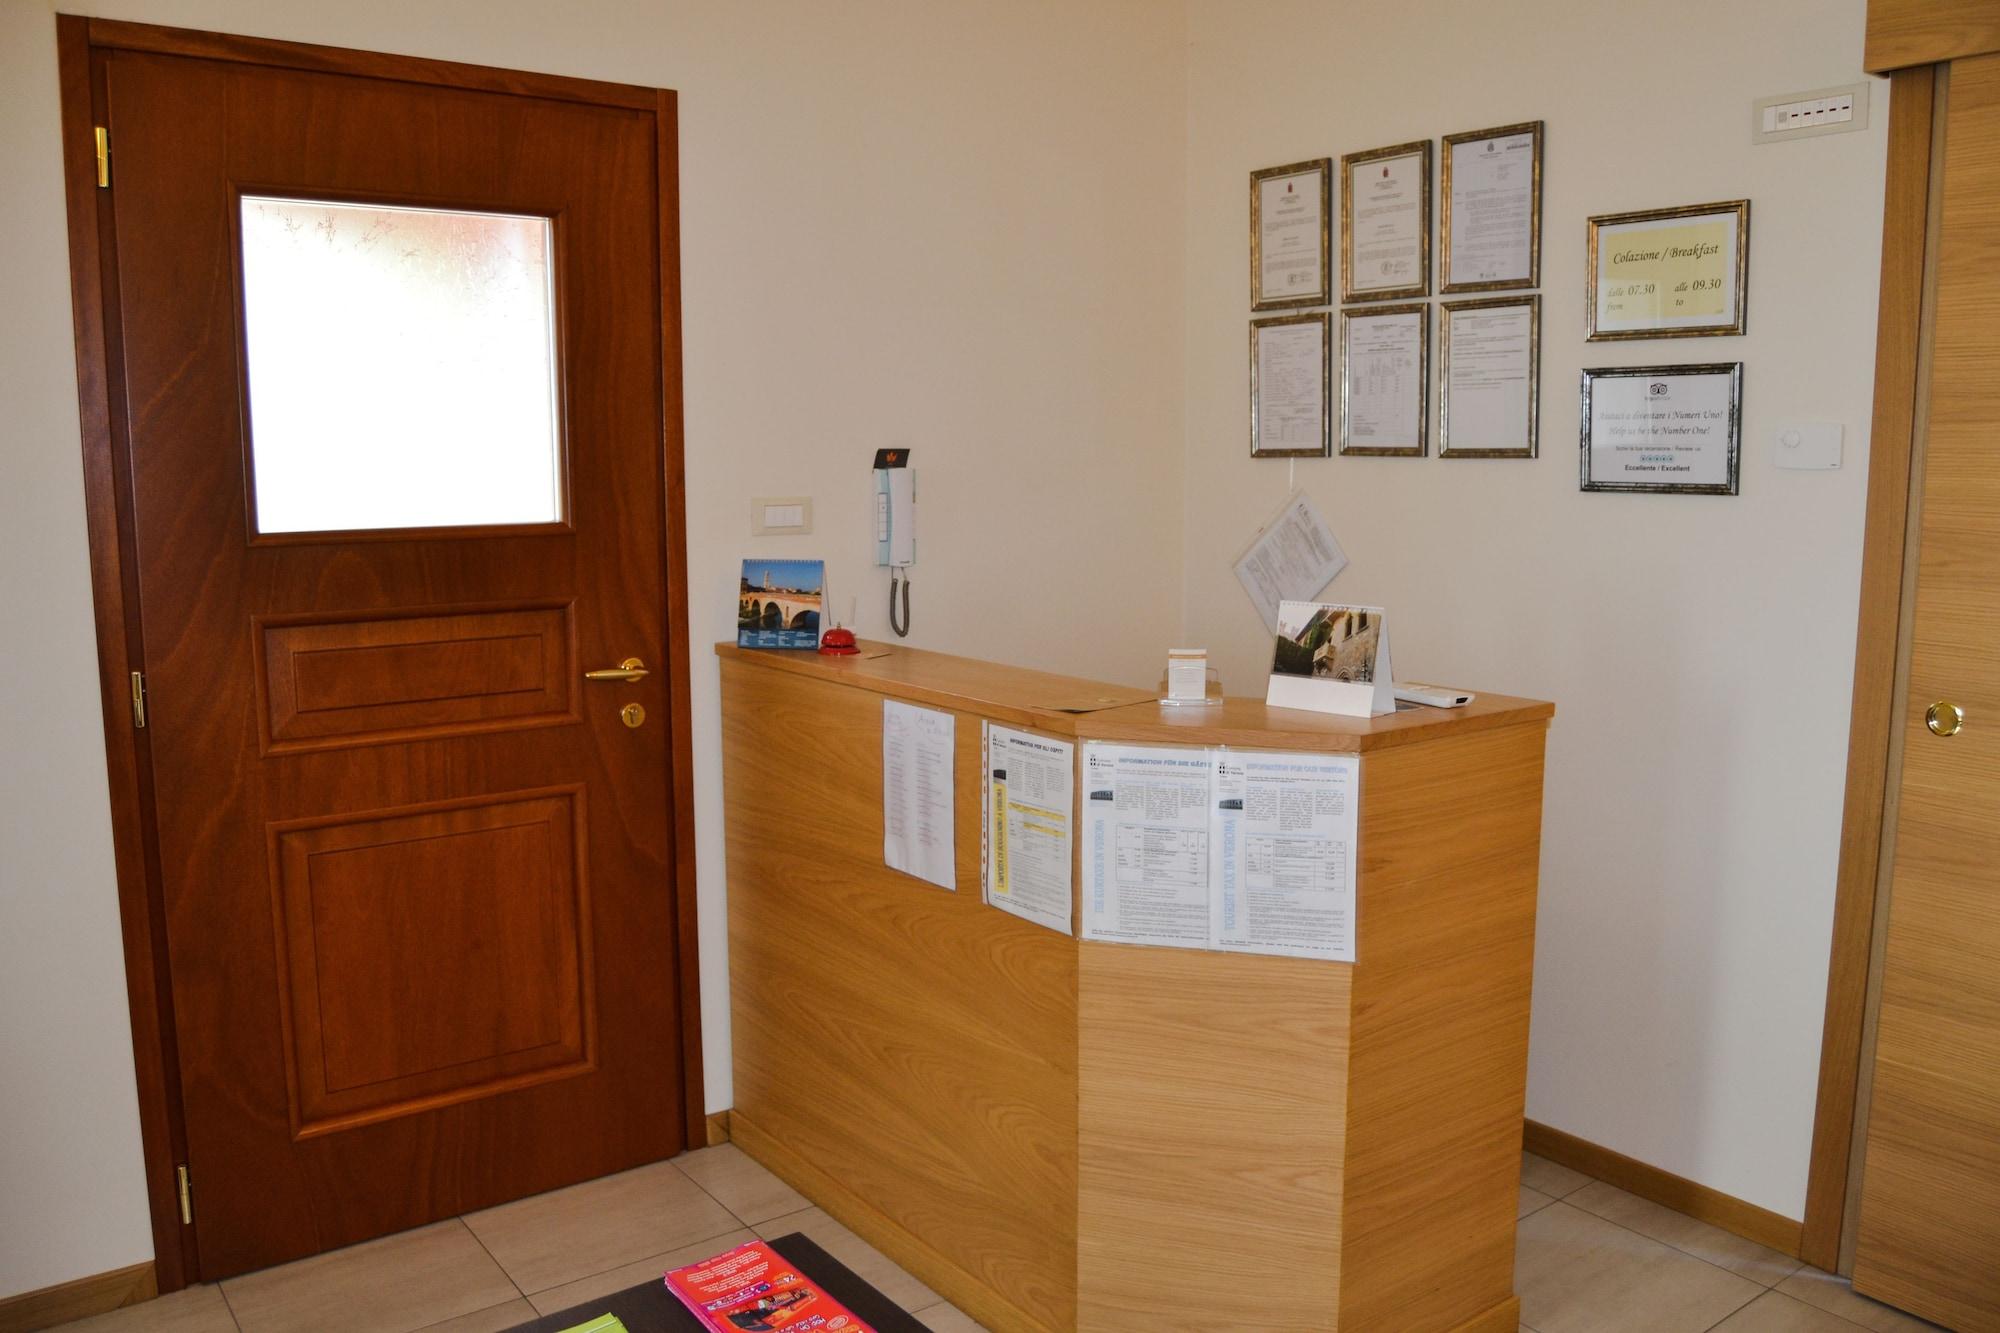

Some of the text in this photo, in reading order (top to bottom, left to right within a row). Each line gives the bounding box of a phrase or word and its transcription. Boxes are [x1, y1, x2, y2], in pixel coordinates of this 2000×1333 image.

[1613, 243, 1719, 264] Colazione / Breakfast
[1628, 284, 1655, 296] 07.30
[1674, 278, 1721, 292] alle 09.30
[1675, 298, 1684, 306] to
[1672, 410, 1700, 420] Numeri
[1704, 410, 1723, 419] Uno!
[1662, 426, 1690, 435] Number
[1692, 426, 1710, 435] One!
